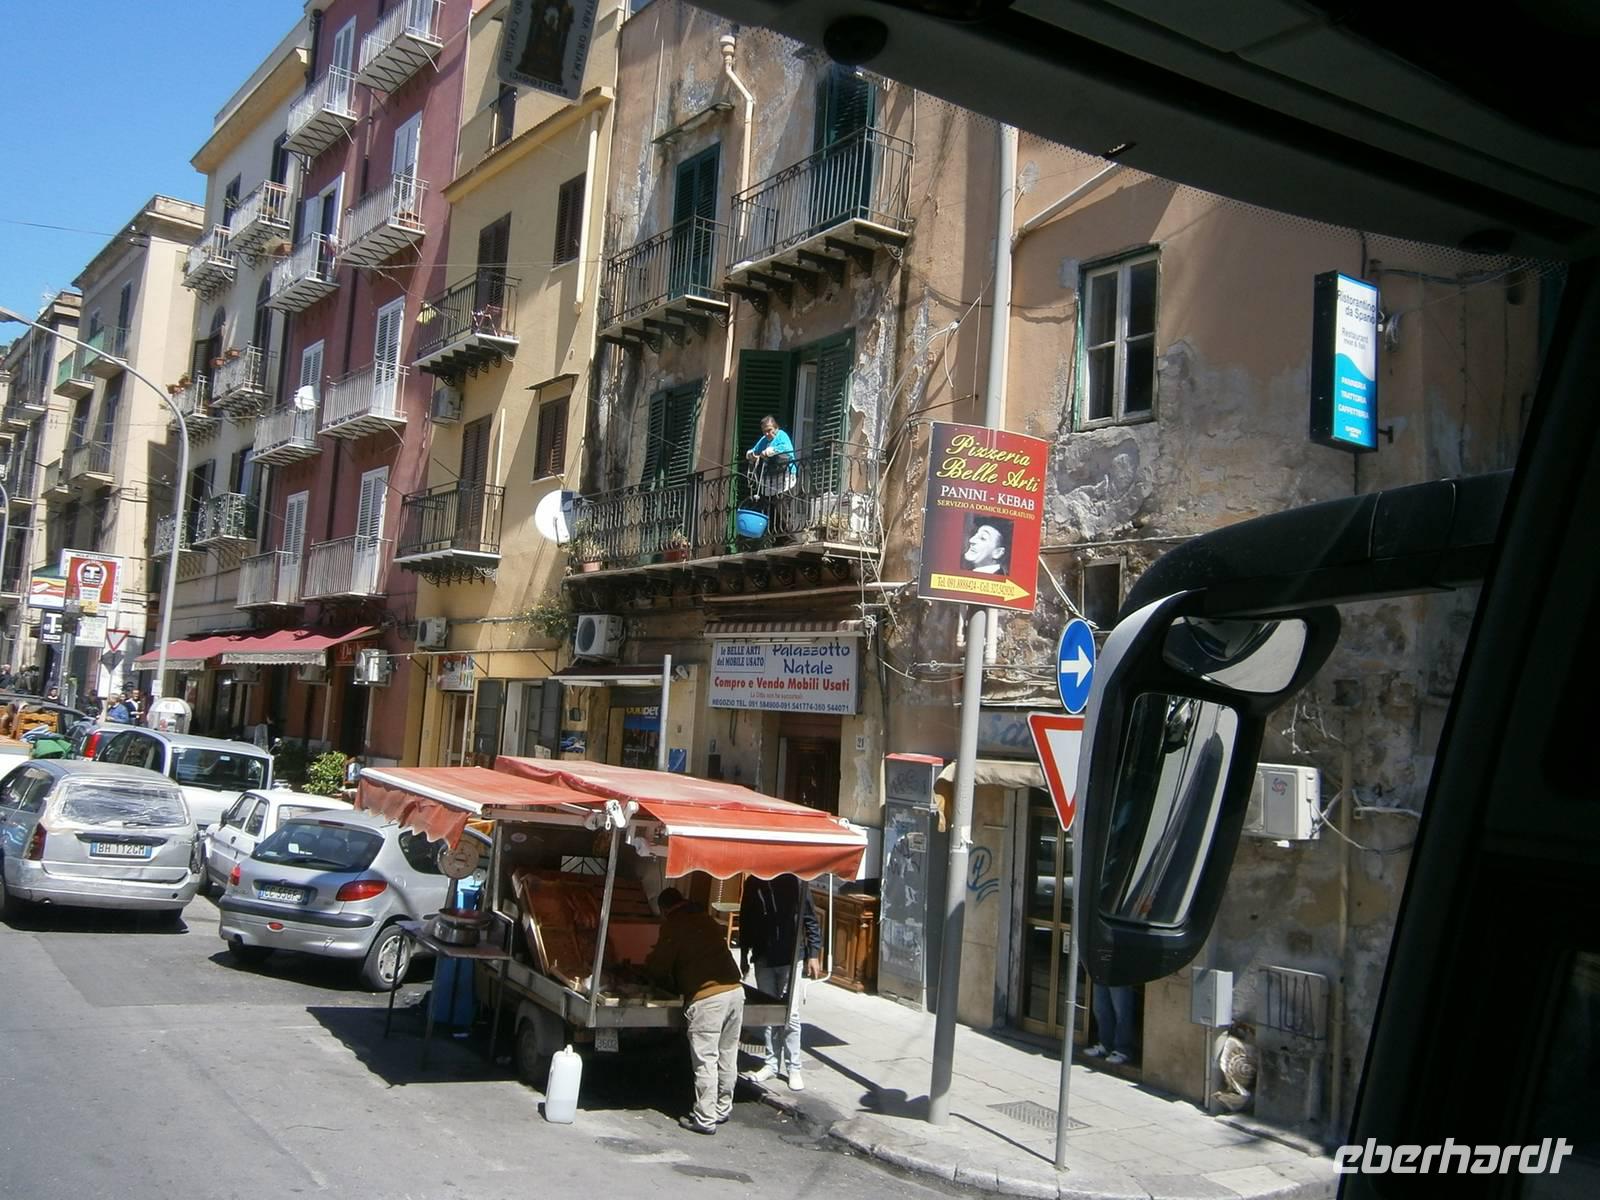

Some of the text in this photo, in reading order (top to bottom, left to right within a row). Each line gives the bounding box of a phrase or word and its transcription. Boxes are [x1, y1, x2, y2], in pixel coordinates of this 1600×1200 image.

[946, 434, 1031, 466] Pizzeria
[936, 457, 1040, 492] Belle Arti
[940, 485, 987, 502] PANINI
[997, 493, 1035, 510] KEBAB
[937, 500, 968, 508] SERVIZIO
[976, 504, 1009, 514] DOMICILIO
[727, 646, 745, 656] BELLE
[746, 646, 760, 655] ARTI
[772, 642, 850, 657] Palazzotto
[724, 657, 745, 666] MOBILE
[746, 657, 764, 666] USATO
[784, 658, 833, 675] Natale
[714, 676, 850, 692] Compro e Vendo Mobili Usati
